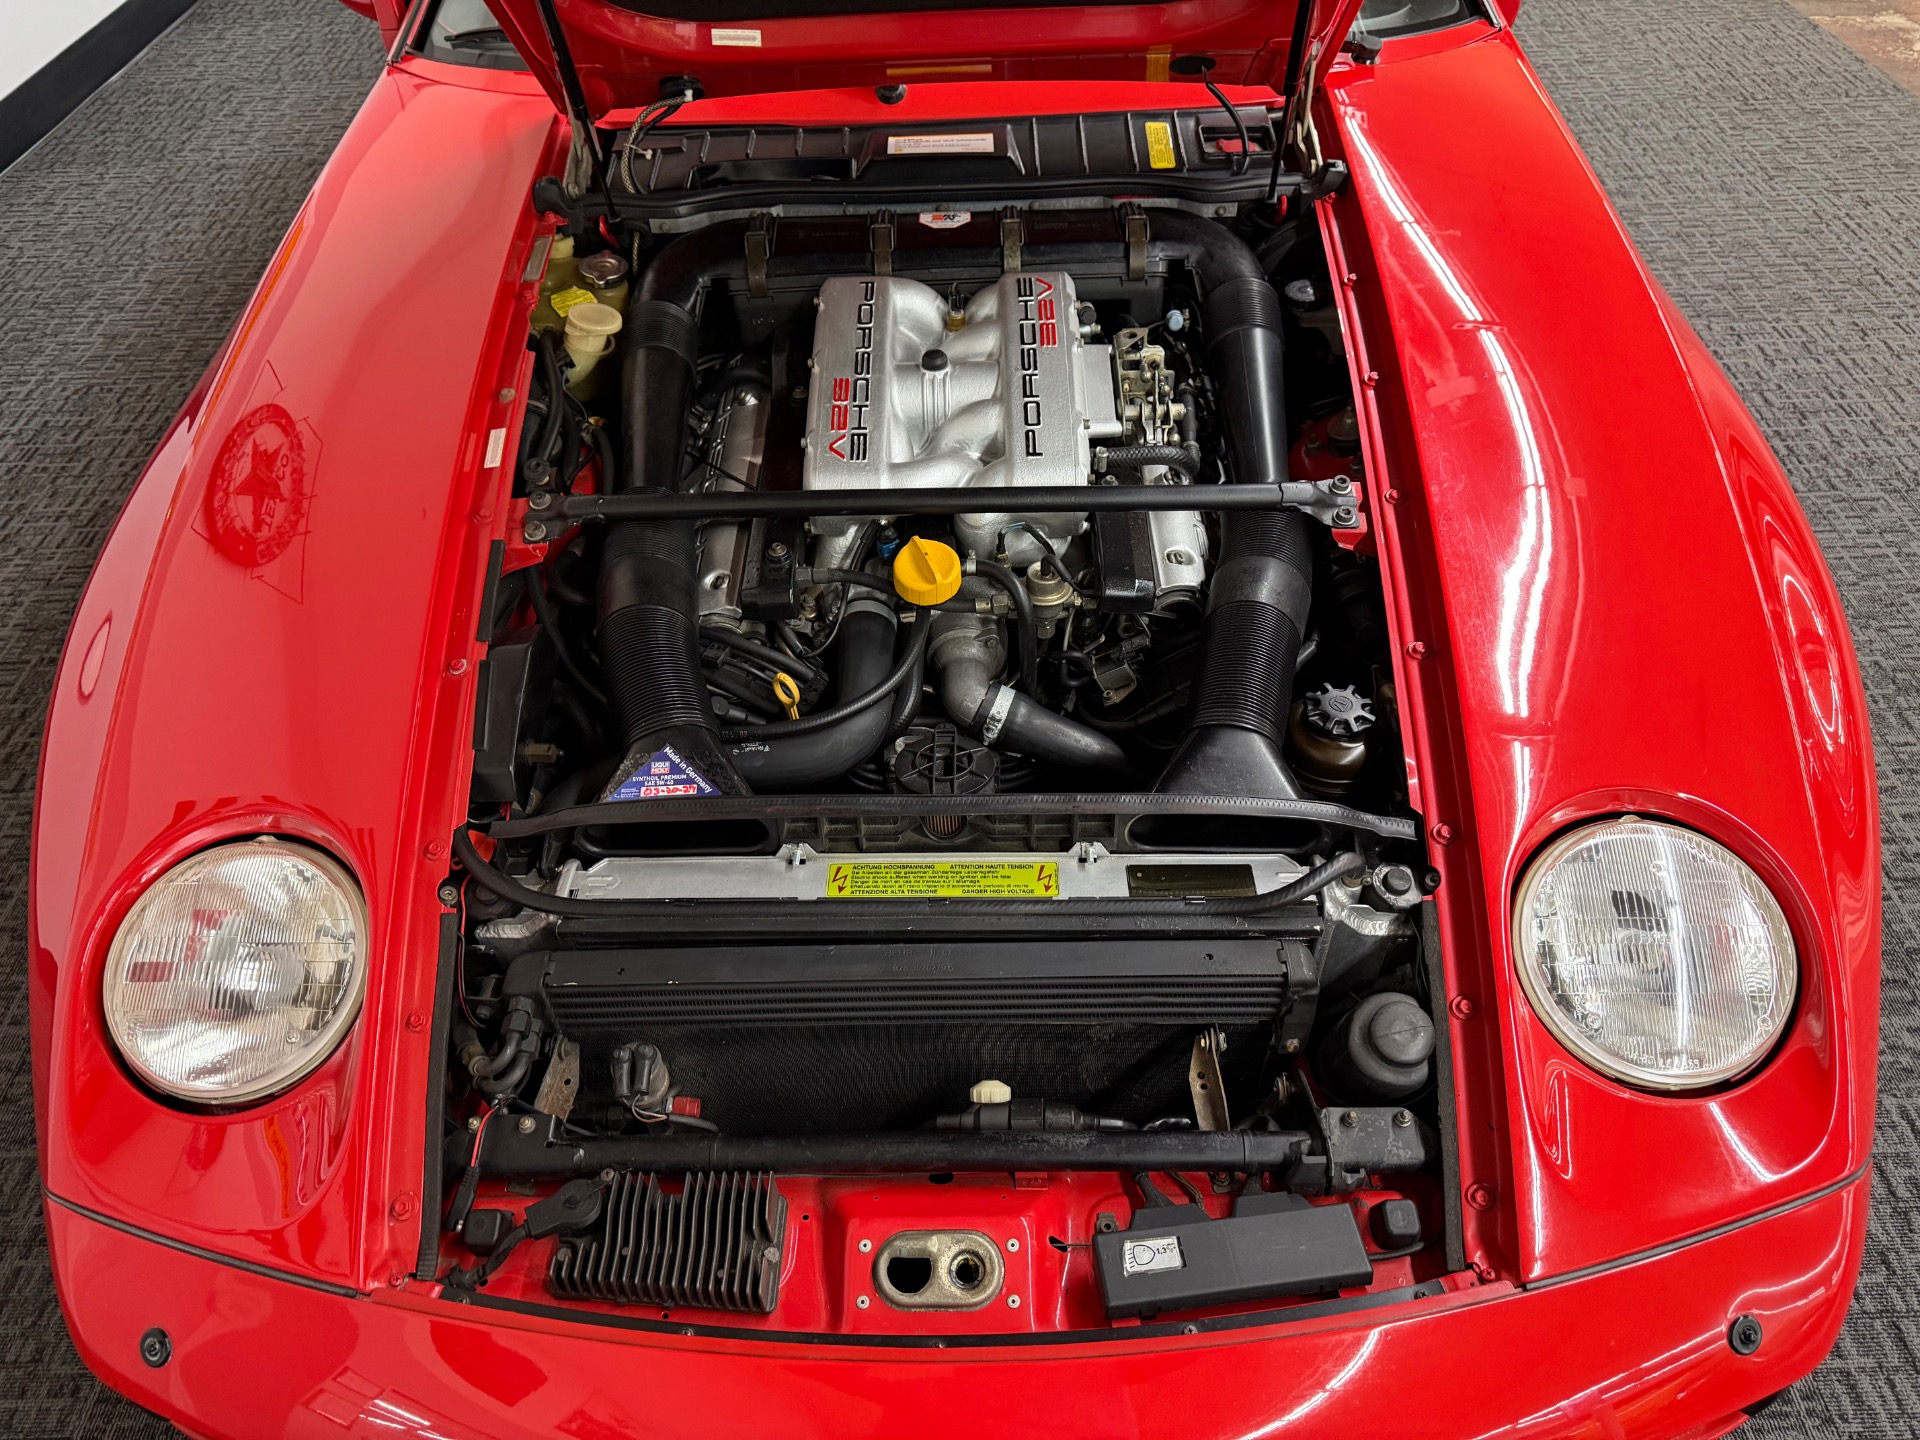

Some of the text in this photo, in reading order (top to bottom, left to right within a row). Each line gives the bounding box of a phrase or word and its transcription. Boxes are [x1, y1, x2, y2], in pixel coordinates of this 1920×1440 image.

[1035, 277, 1058, 348] 32V
[850, 281, 876, 463] PORSCHE
[1015, 276, 1044, 459] PORSCHE
[828, 377, 850, 461] 32V
[663, 746, 713, 794] Made in Germany
